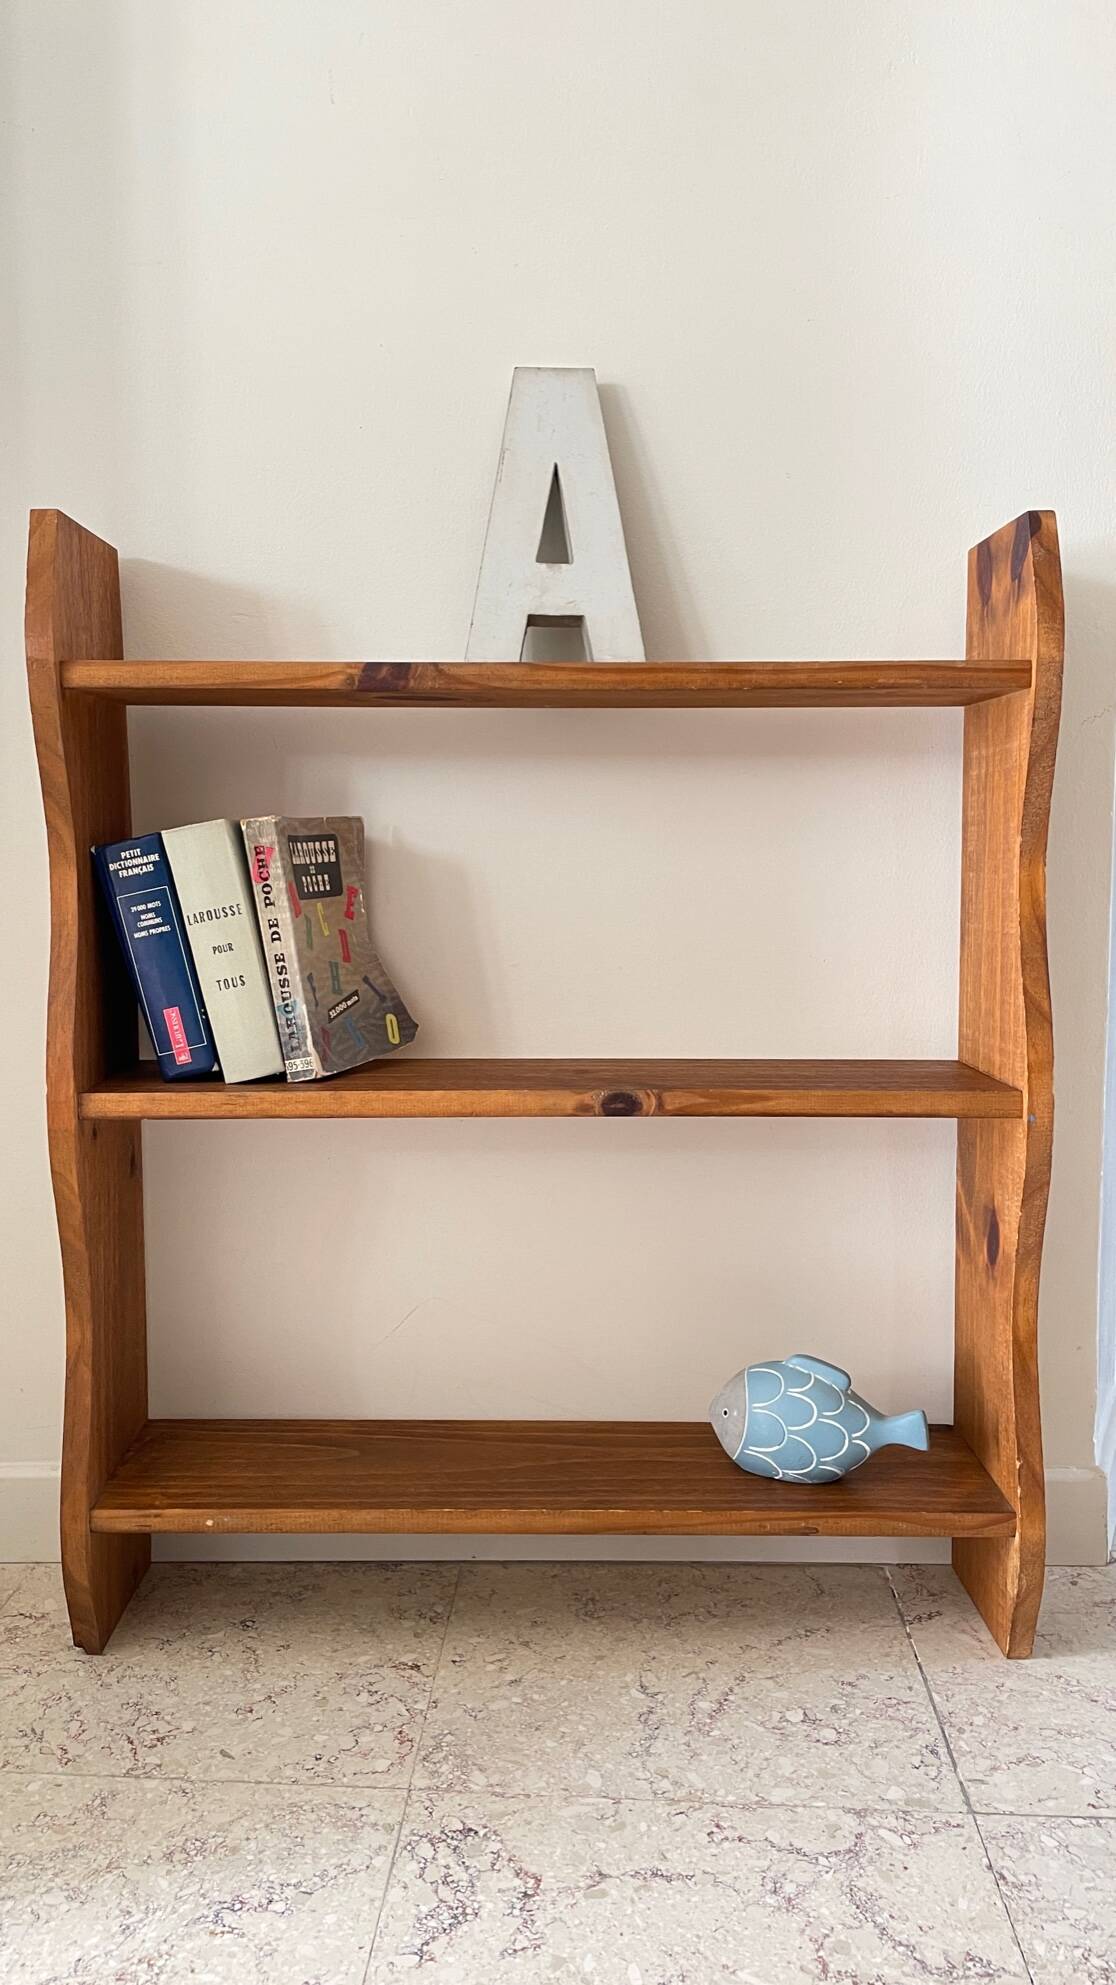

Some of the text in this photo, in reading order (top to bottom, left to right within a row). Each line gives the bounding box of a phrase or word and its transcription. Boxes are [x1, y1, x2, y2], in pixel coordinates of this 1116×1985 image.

[465, 366, 647, 661] A
[108, 853, 160, 871] DICTIONNAIRE
[120, 848, 141, 859] PETIT
[289, 840, 336, 864] LAROUSSE
[119, 863, 154, 878] FRANÇAIS
[254, 845, 276, 908] POCHE
[186, 903, 243, 926] LAROUSSE
[268, 918, 282, 943] DE
[212, 942, 234, 955] POUR
[216, 975, 246, 991] TOUS
